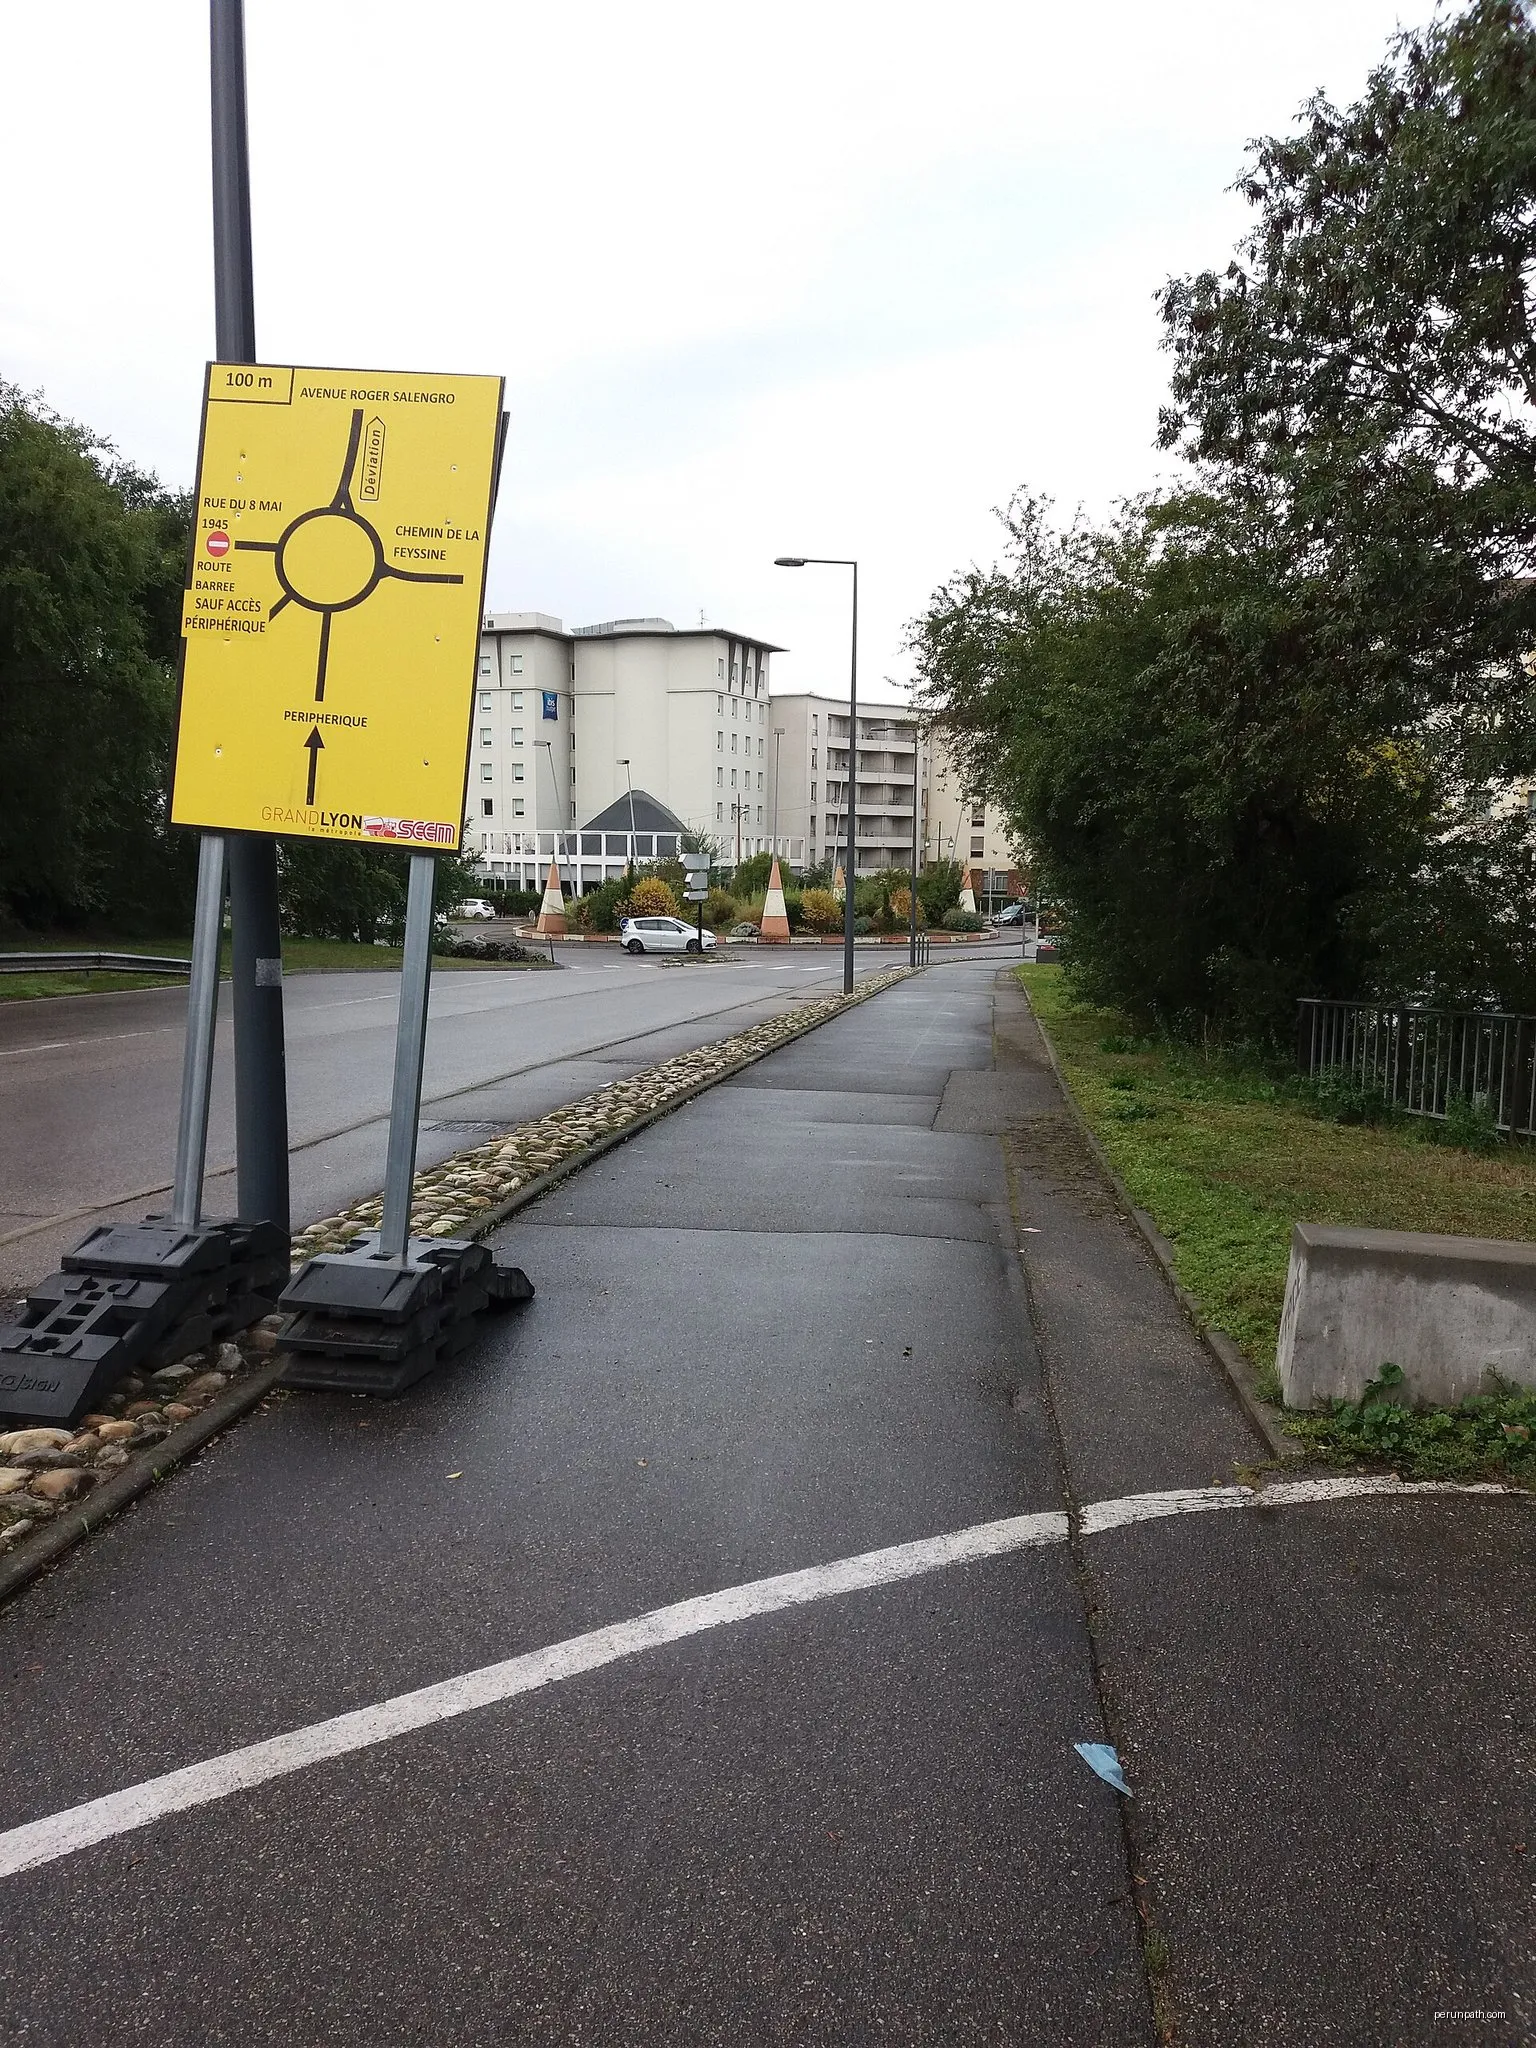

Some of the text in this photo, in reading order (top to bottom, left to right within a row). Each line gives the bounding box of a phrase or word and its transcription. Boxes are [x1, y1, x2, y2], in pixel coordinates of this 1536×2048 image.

[225, 372, 273, 389] 100 m
[299, 387, 456, 405] AVENUE ROGER SALENGRO
[364, 428, 381, 496] Déviation
[203, 497, 283, 512] RUE DU 8 MAI
[201, 518, 229, 530] 1945
[395, 525, 480, 541] CHEMIN DE LA
[393, 546, 447, 560] FEYSSINE
[197, 561, 232, 573] ROUTE
[195, 580, 235, 592] BARREE
[195, 597, 261, 613] SAUF ACCÈS
[185, 615, 266, 633] PÉRIPHÉRIQUE
[284, 710, 368, 727] PERIPHERIQUE
[397, 819, 455, 844] SEEM
